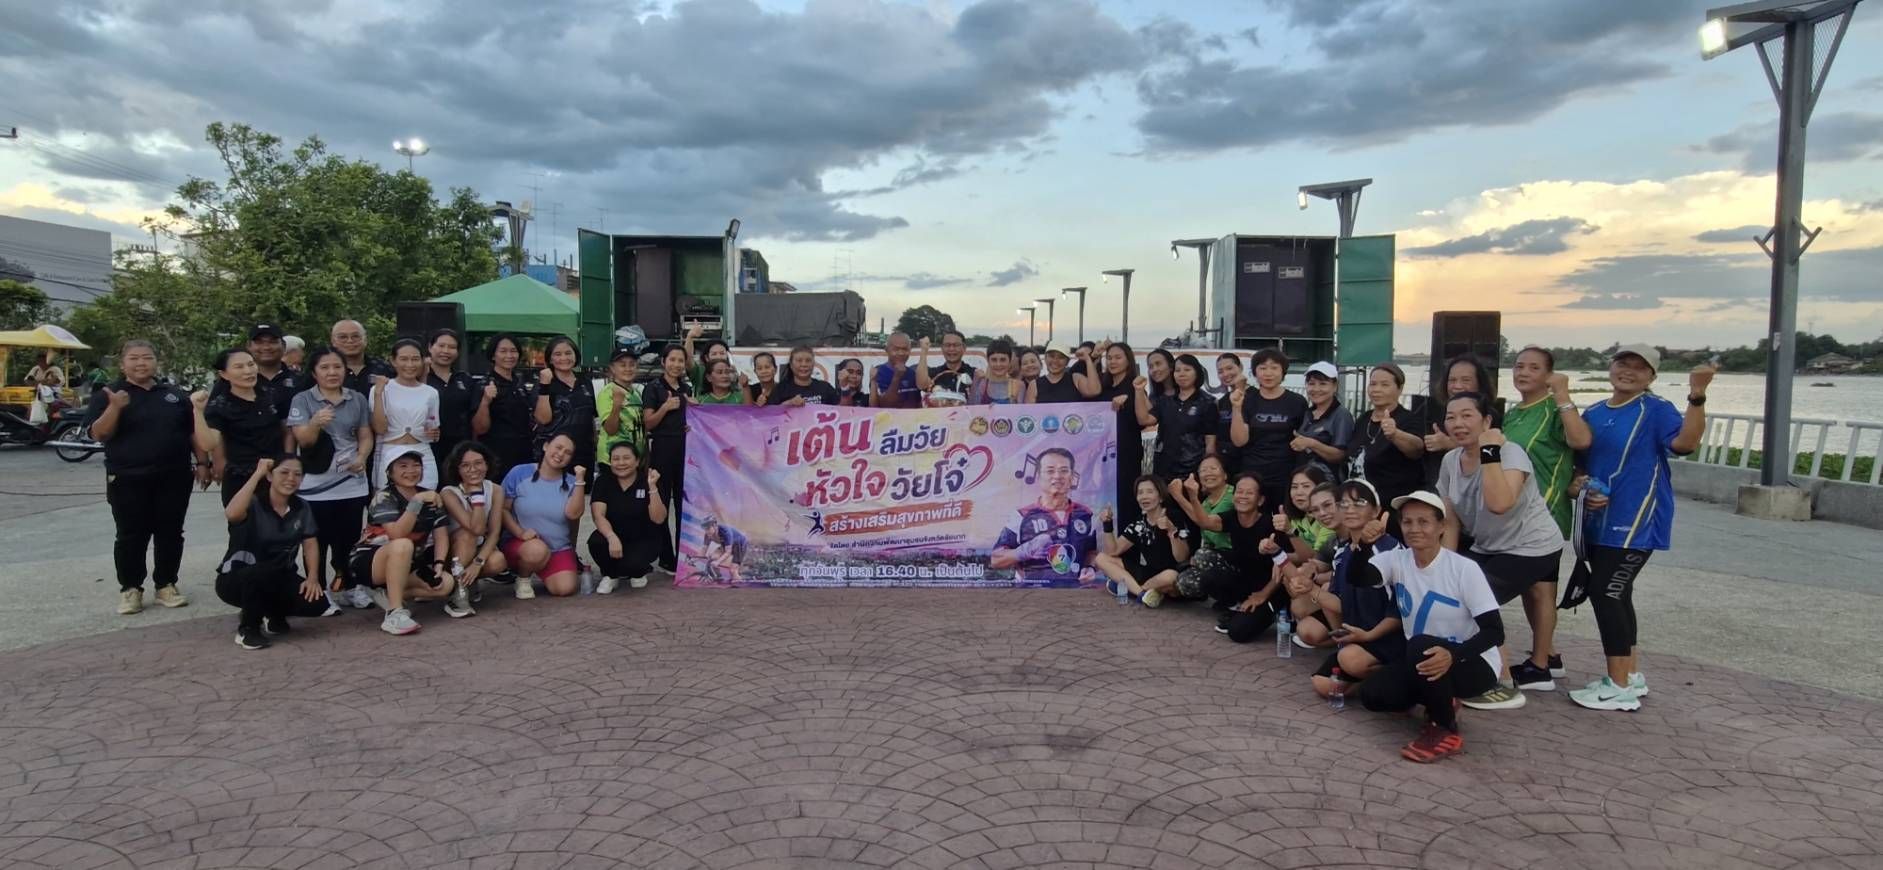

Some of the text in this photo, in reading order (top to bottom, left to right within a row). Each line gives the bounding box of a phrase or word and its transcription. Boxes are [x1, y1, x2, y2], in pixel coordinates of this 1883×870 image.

[786, 412, 947, 466] เต้น ลืมวัย
[805, 457, 968, 507] หัวใจ วัยโจ๋
[829, 501, 962, 533] สร้างเสริมสุขภาพที่ดี
[876, 565, 916, 577] 16.40
[1604, 553, 1643, 601] ADIDAS
